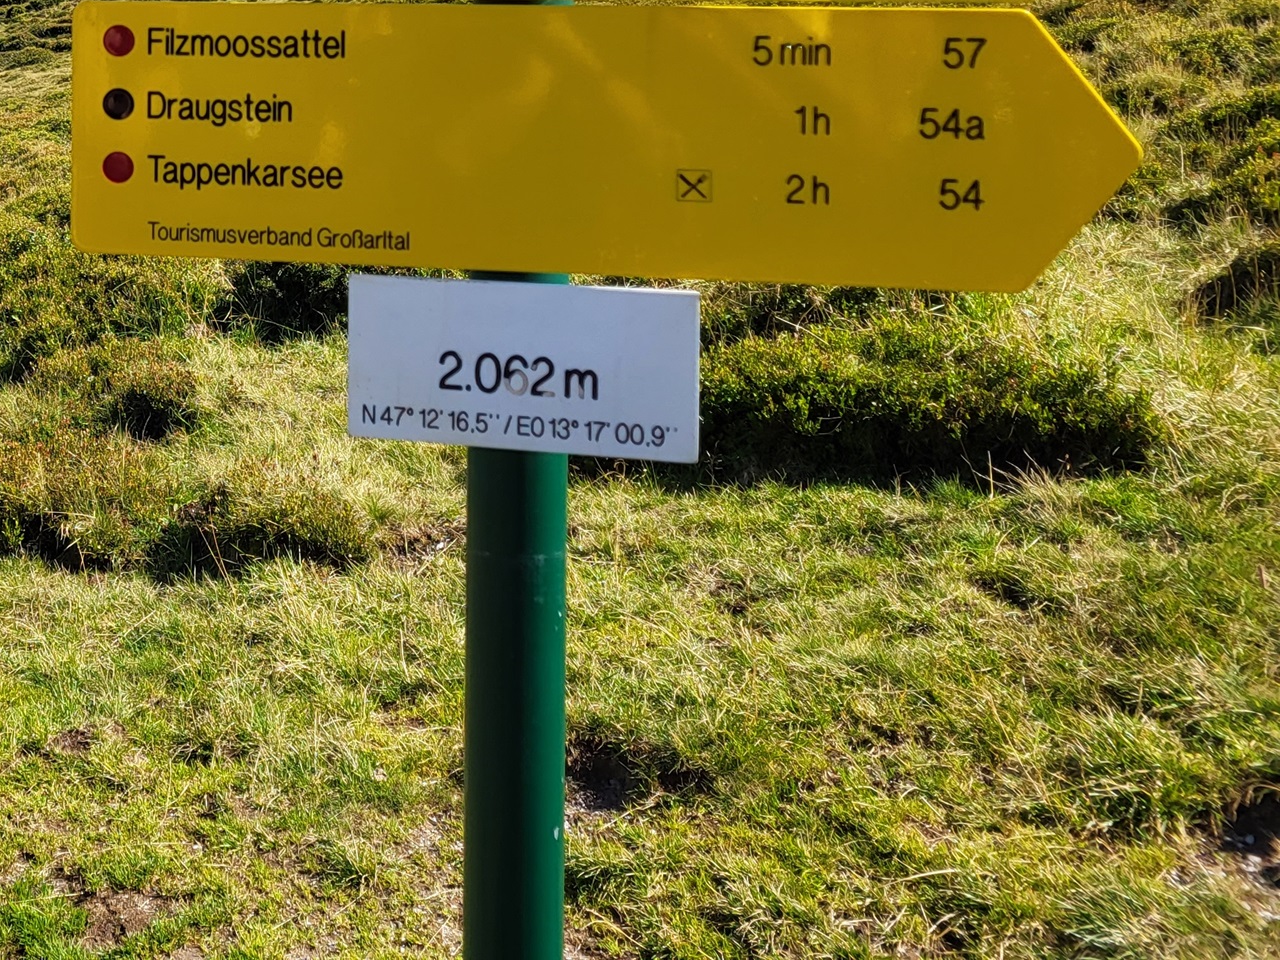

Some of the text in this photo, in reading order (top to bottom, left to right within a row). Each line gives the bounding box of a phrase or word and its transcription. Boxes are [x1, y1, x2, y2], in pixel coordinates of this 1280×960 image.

[146, 27, 347, 59] Filzmoossattel
[942, 37, 988, 69] 57
[146, 91, 293, 127] Draugstein
[918, 107, 986, 140] 54a
[146, 154, 344, 191] Tappenkarsee
[937, 178, 986, 211] 54
[146, 220, 411, 252] Tourismusverband Großarltal
[437, 349, 556, 398] 2.062
